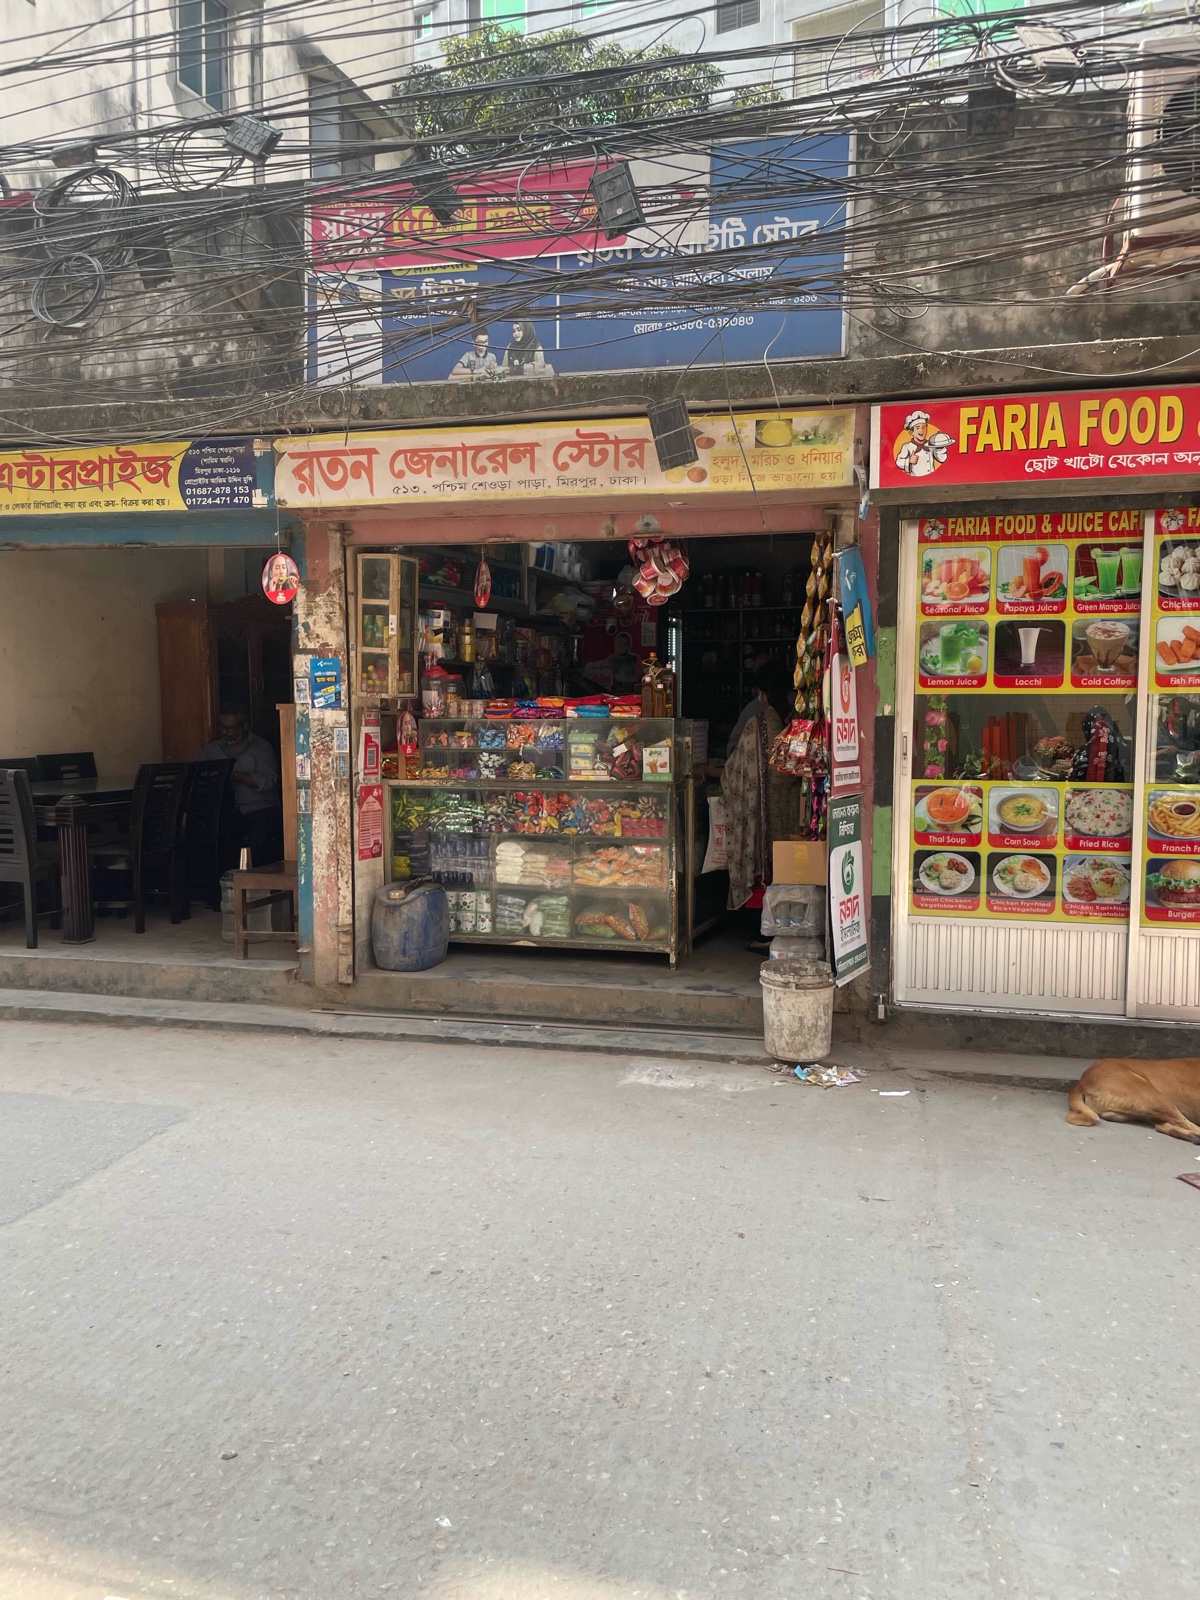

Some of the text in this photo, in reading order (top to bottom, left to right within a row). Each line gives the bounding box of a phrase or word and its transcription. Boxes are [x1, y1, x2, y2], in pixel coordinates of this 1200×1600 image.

[959, 395, 1184, 454] FARIA FOOD
[287, 428, 652, 497] রতন জেনারেল স্টোর
[751, 450, 780, 467] মরিচ
[786, 455, 795, 465] ও
[801, 449, 843, 465] ধনিয়ার
[1025, 455, 1059, 473] ছোট
[1064, 453, 1104, 470] খাটো
[738, 472, 766, 483] নিজে
[186, 486, 231, 495] 01687-878
[432, 480, 467, 492] পশ্চিম
[78, 501, 87, 509] হয়
[89, 500, 102, 508] এবং
[141, 498, 154, 506] করা
[186, 496, 250, 505] 01724-471 470
[948, 516, 990, 536] FARIA
[995, 514, 1036, 535] FOOD
[1041, 514, 1052, 533] &
[1057, 511, 1104, 533] JUICE
[1004, 603, 1058, 613] Papaya Juice
[1077, 603, 1098, 611] Green
[1099, 603, 1123, 612] Mango
[1162, 600, 1199, 608] Chicken
[925, 605, 985, 614] Seasonal Juice
[927, 678, 978, 686] Lemon Juice
[1015, 678, 1042, 686] Lacchi
[1081, 677, 1132, 686] Cold Coffee
[1170, 677, 1186, 685] Fish
[836, 718, 856, 744] নগদ
[929, 835, 966, 845] Thai Soup
[1004, 838, 1041, 847] Corn Soup
[1080, 840, 1120, 848] Fried Rice
[1162, 844, 1192, 852] Franch
[839, 894, 859, 925] নগদ
[1168, 910, 1196, 919] Burger
